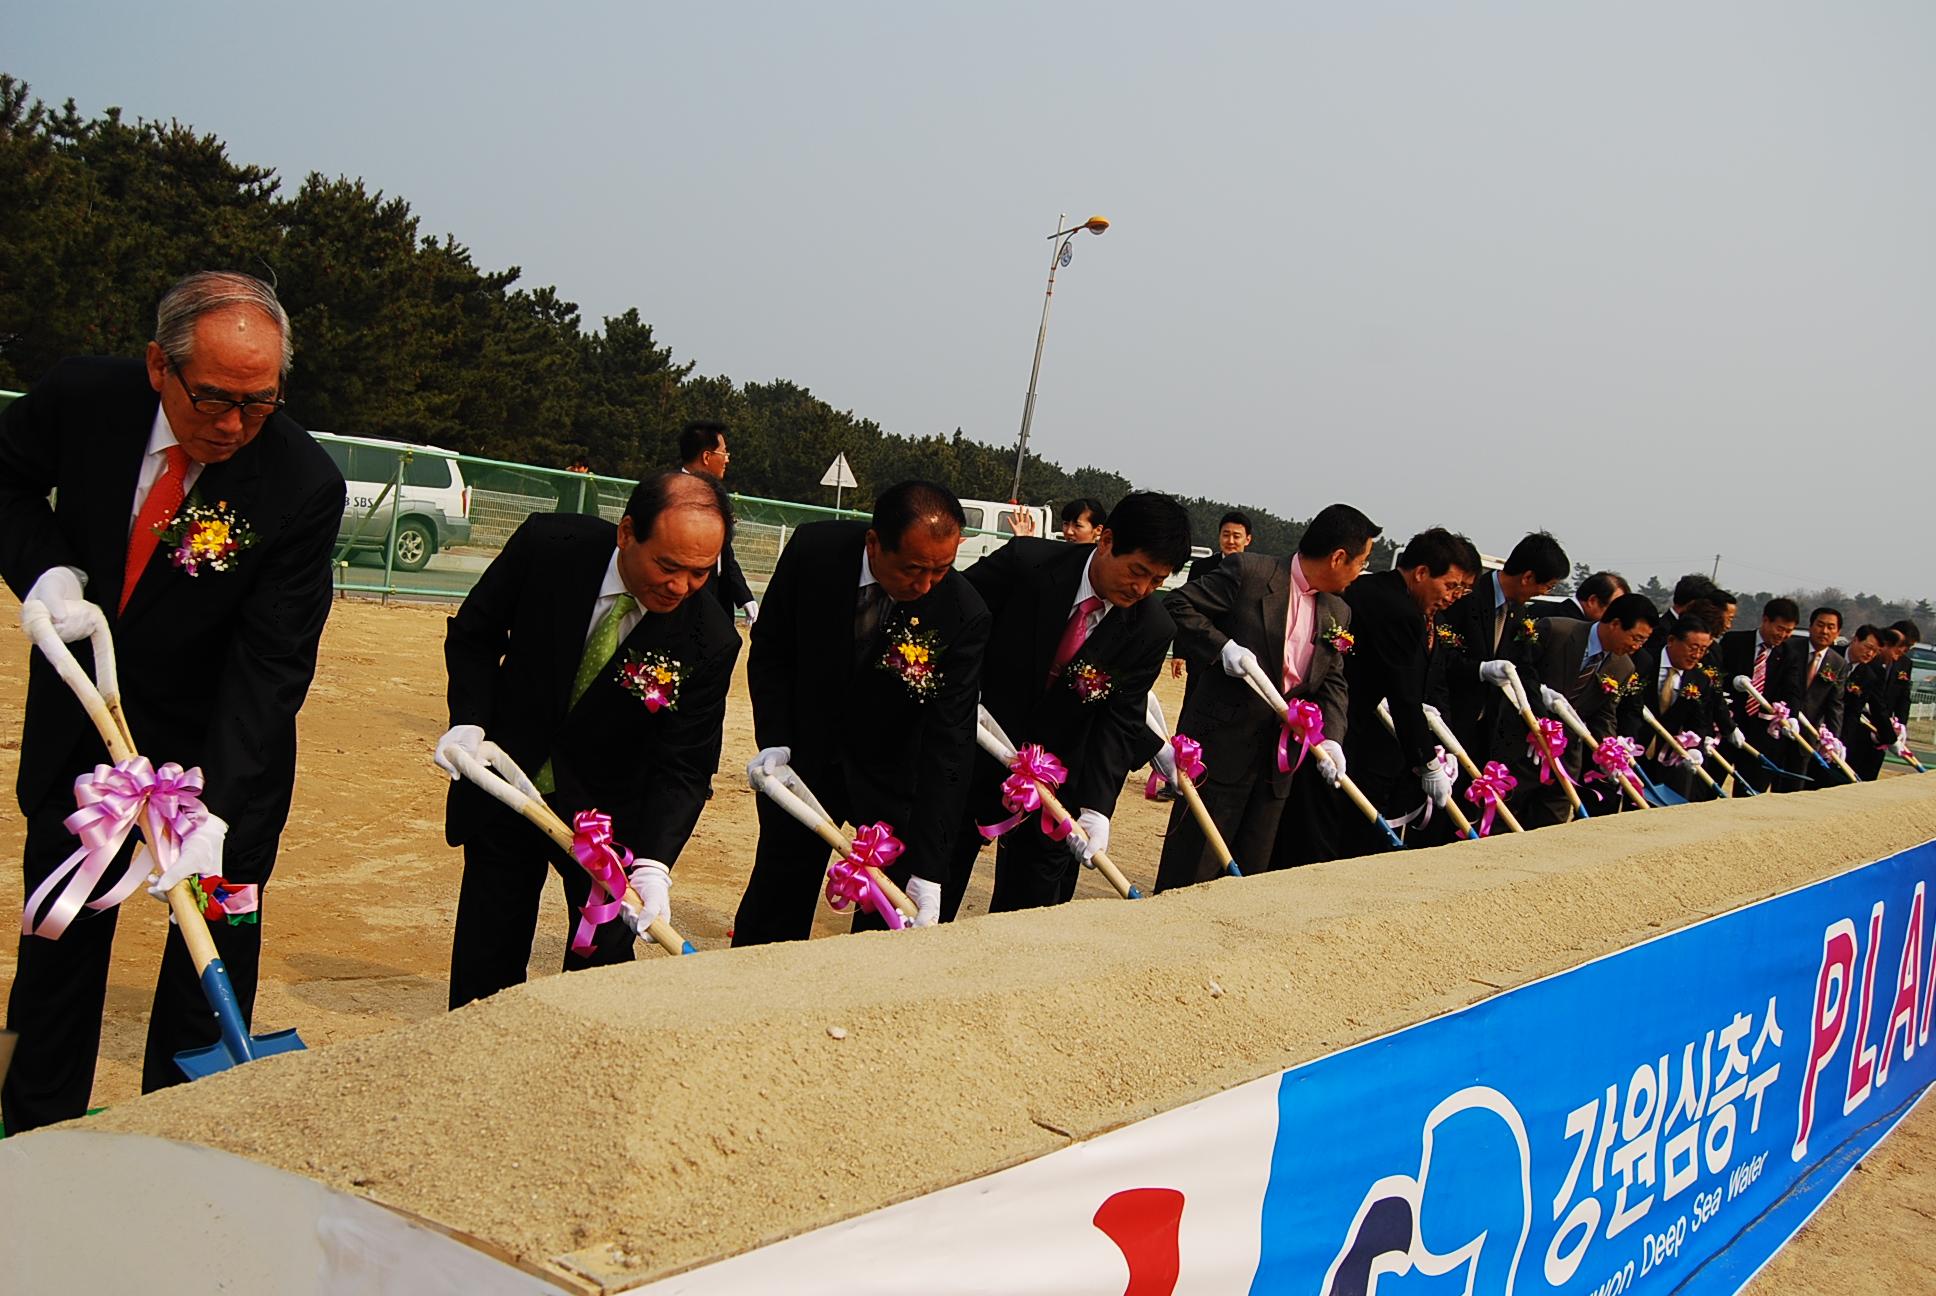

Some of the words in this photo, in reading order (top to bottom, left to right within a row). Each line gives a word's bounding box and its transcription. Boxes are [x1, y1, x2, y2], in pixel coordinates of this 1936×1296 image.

[353, 496, 374, 508] SBS
[1544, 996, 1784, 1287] 강원심층수
[1640, 1215, 1687, 1278] Deep
[1691, 1186, 1723, 1233] Sea
[1727, 1150, 1769, 1202] Water
